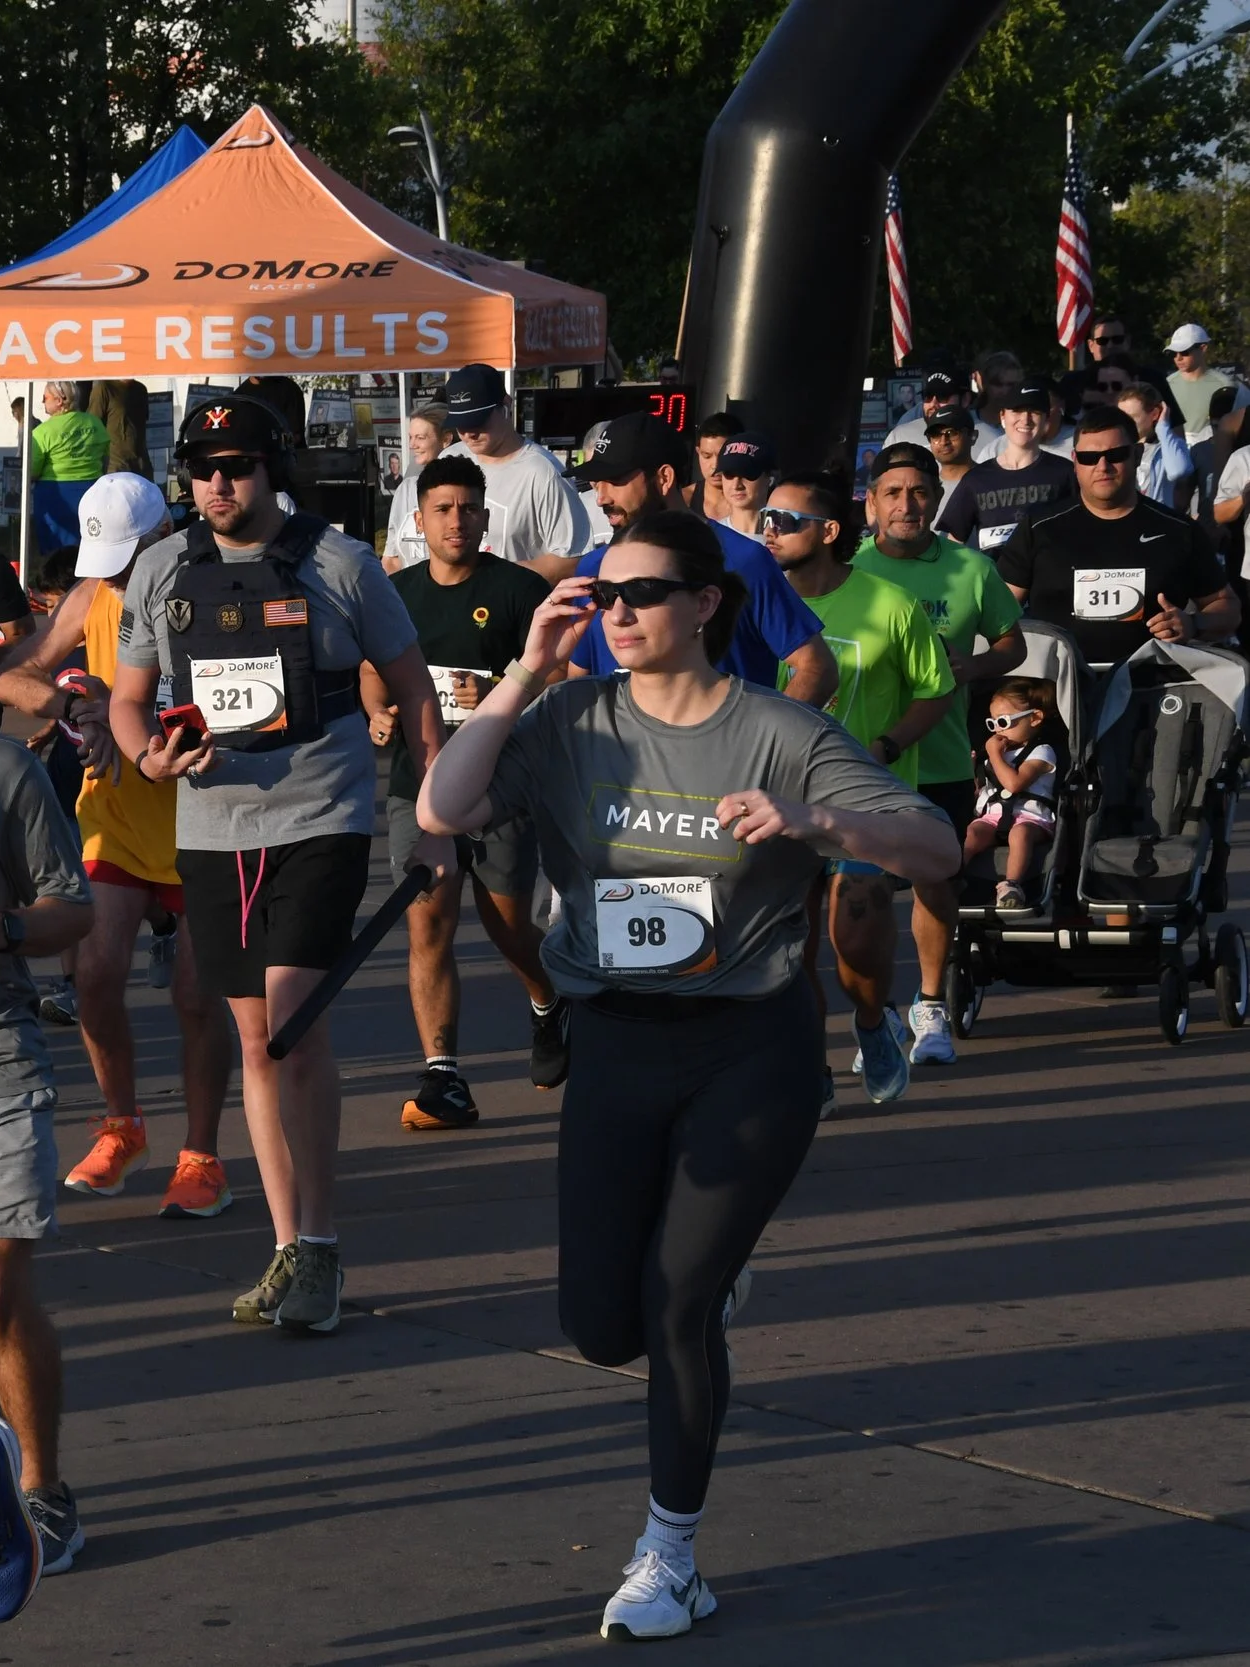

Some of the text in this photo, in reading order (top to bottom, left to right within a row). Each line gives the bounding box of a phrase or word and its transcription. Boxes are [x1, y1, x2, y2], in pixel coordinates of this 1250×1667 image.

[249, 283, 317, 291] RACES
[155, 311, 449, 360] RESULTS
[723, 441, 760, 457] FDNY
[989, 527, 1013, 538] 132
[1088, 590, 1121, 606] 311
[221, 611, 237, 622] 22
[212, 687, 253, 711] 321
[606, 804, 720, 840] MAYER
[628, 917, 666, 947] 98
